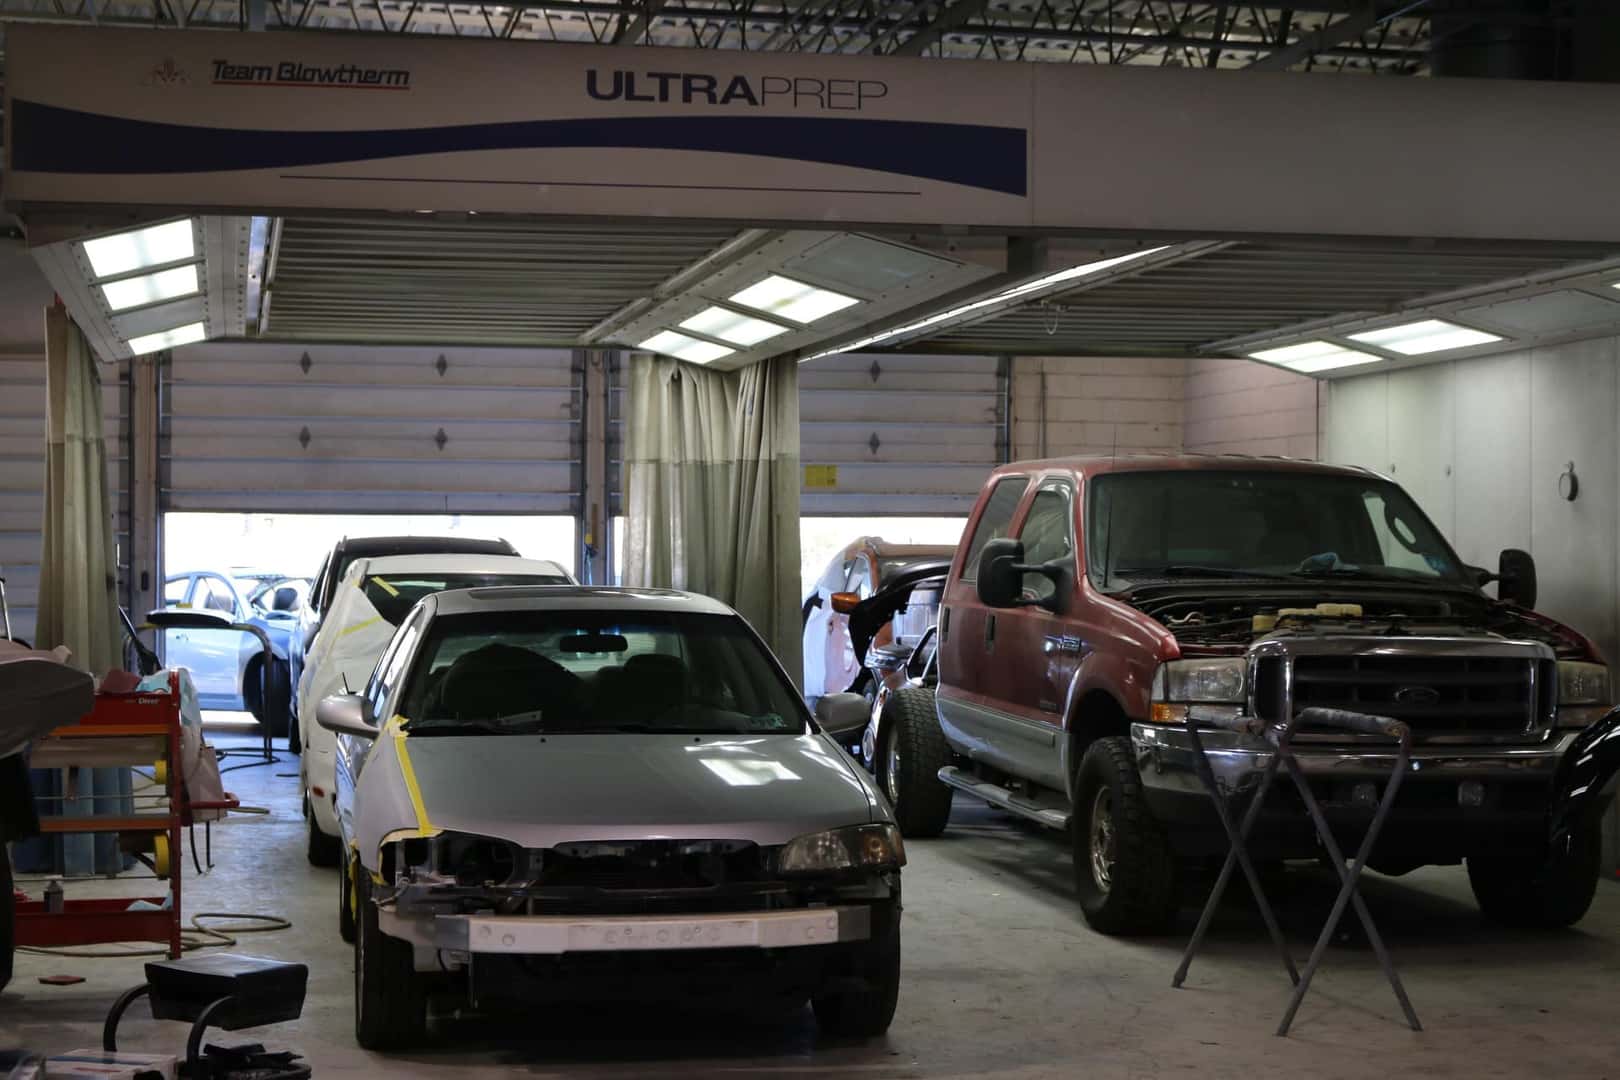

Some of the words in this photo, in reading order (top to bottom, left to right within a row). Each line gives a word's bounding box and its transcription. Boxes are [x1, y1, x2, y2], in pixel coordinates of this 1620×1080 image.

[212, 59, 272, 81] Team
[276, 61, 410, 86] Blowtherm
[586, 69, 888, 110] ULTRAPREP
